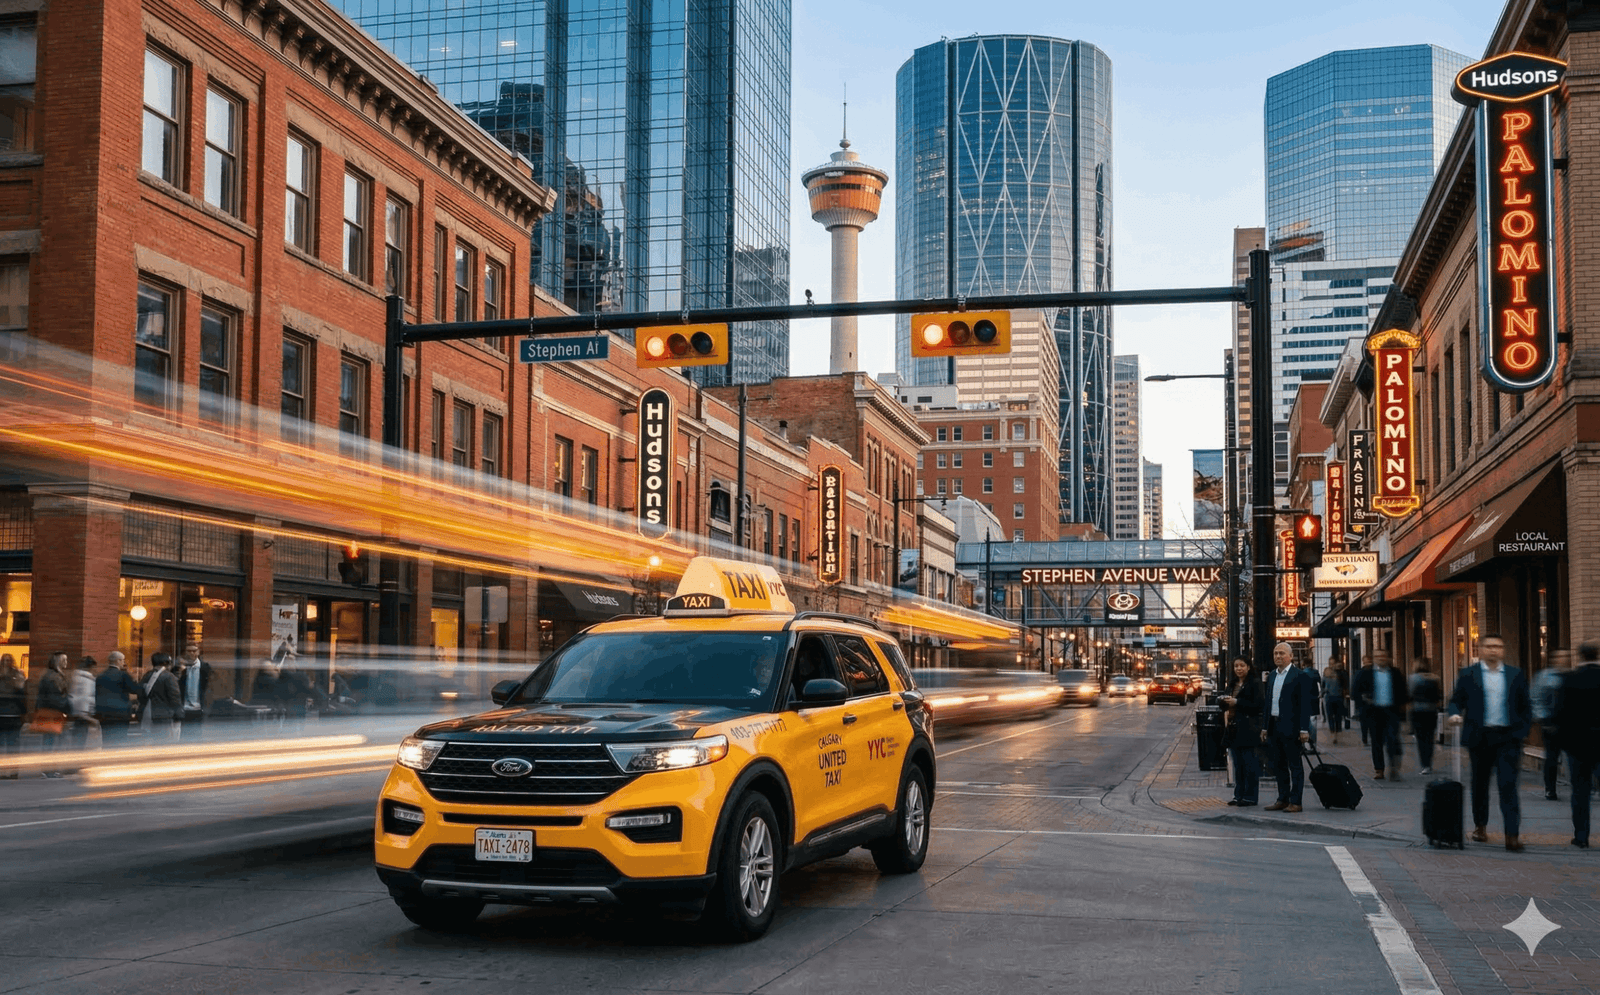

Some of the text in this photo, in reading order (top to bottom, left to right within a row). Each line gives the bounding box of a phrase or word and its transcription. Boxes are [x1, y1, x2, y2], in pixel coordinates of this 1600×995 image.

[1471, 68, 1558, 88] Hudsons
[1498, 112, 1540, 369] PALOMINO
[528, 342, 580, 360] Stephen
[1384, 354, 1406, 491] PALOMINO
[646, 403, 663, 524] Hudsons
[1515, 532, 1549, 541] LOCAL
[1499, 542, 1565, 552] RESTAURANT
[1022, 568, 1221, 583] STEPHEN AVENUE WALK
[722, 571, 786, 600] TAXI YYC
[682, 596, 711, 608] YAXI
[818, 733, 842, 749] CALGARY
[868, 738, 886, 760] YYC
[500, 761, 522, 772] Ford
[818, 750, 847, 769] UNITED
[825, 769, 842, 788] TAXI
